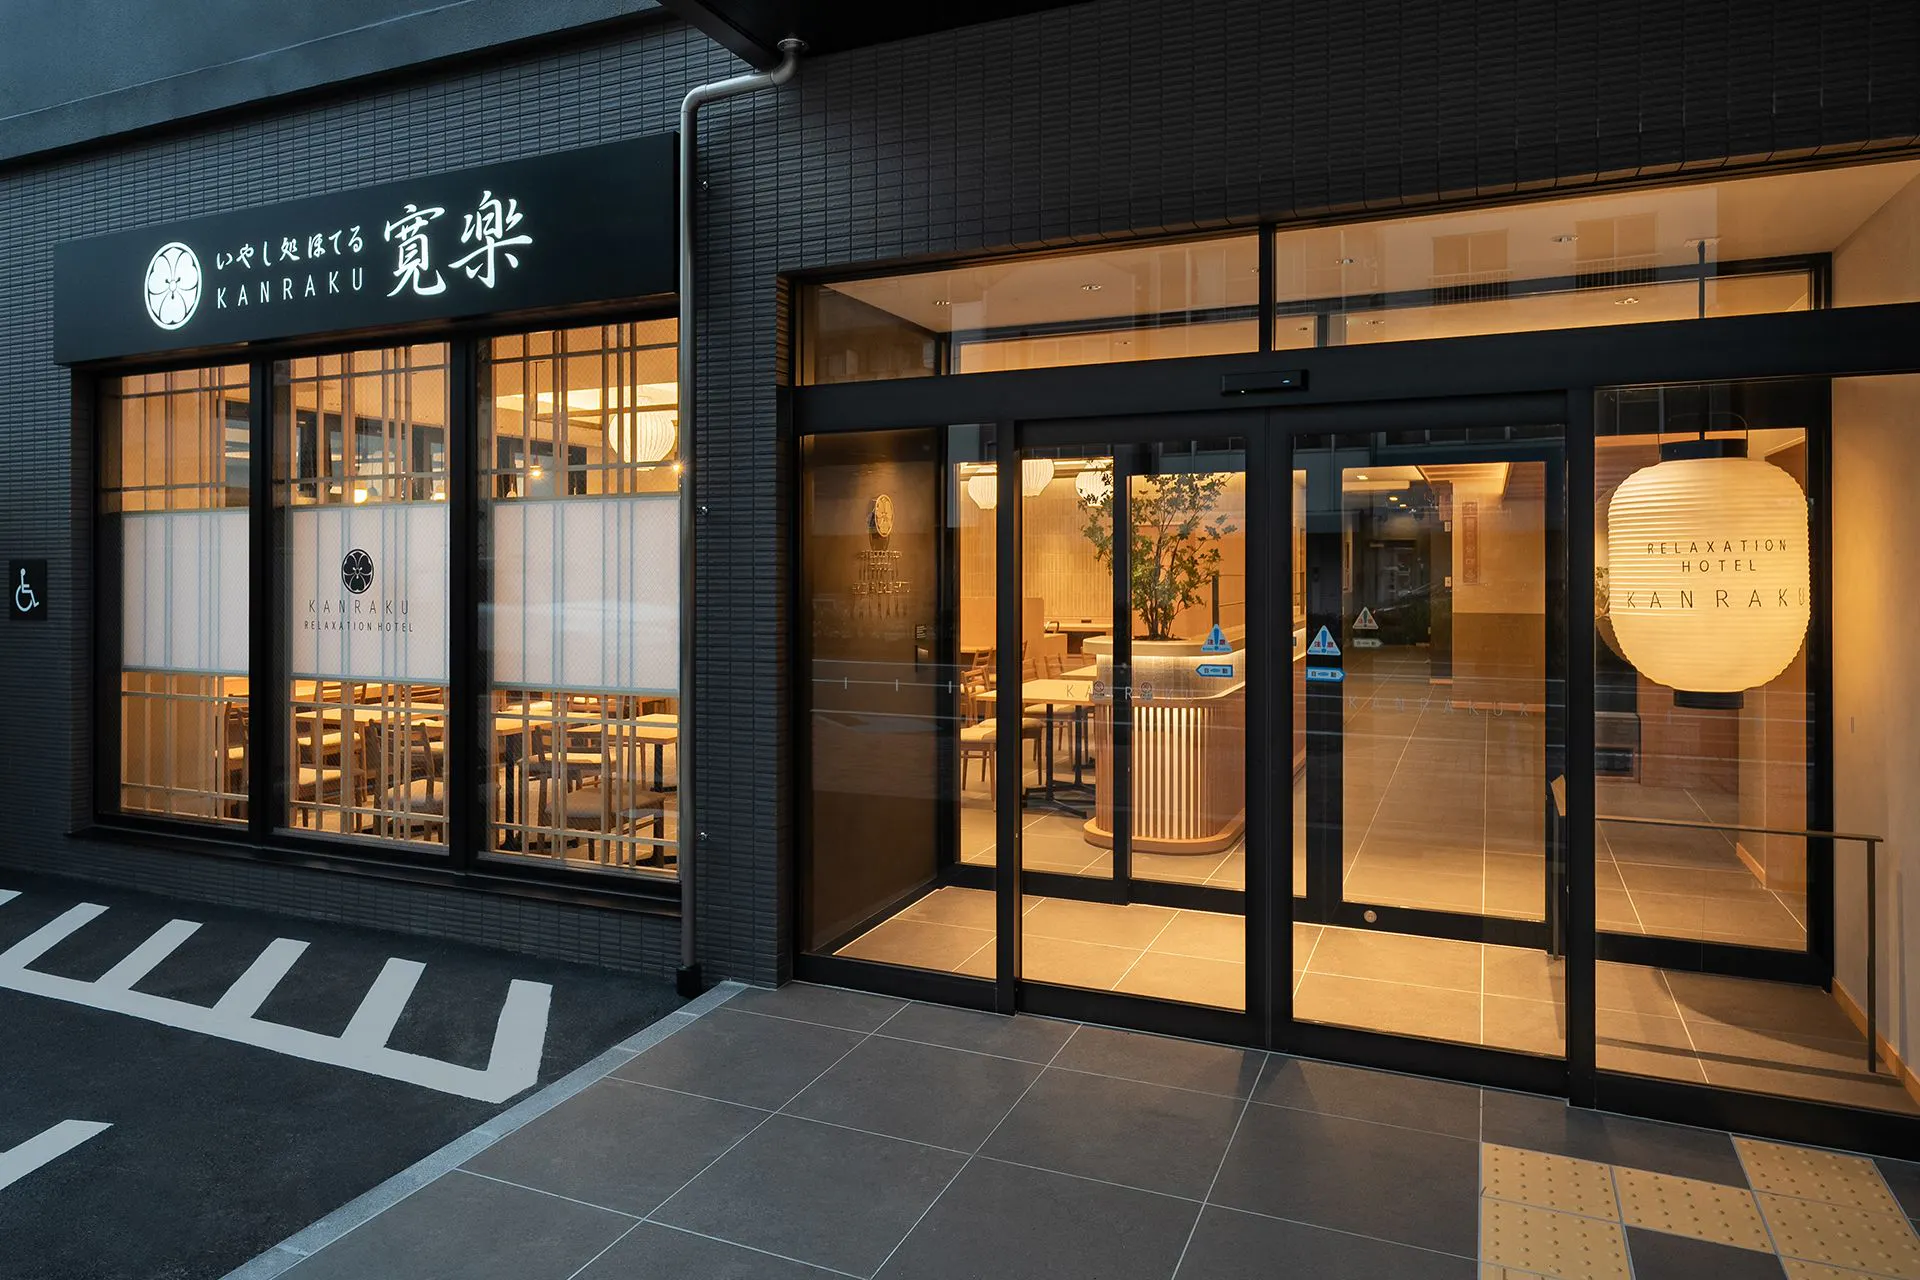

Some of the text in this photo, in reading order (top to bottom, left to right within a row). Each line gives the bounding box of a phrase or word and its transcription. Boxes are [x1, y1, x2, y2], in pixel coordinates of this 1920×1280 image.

[216, 225, 364, 270] いやし処ほてる
[217, 267, 363, 309] KANRAKU
[1647, 539, 1787, 555] RELAXATION
[1682, 559, 1756, 573] HOTEL
[309, 600, 408, 614] KANRAKU
[304, 620, 413, 633] RELAXATION HOTEL
